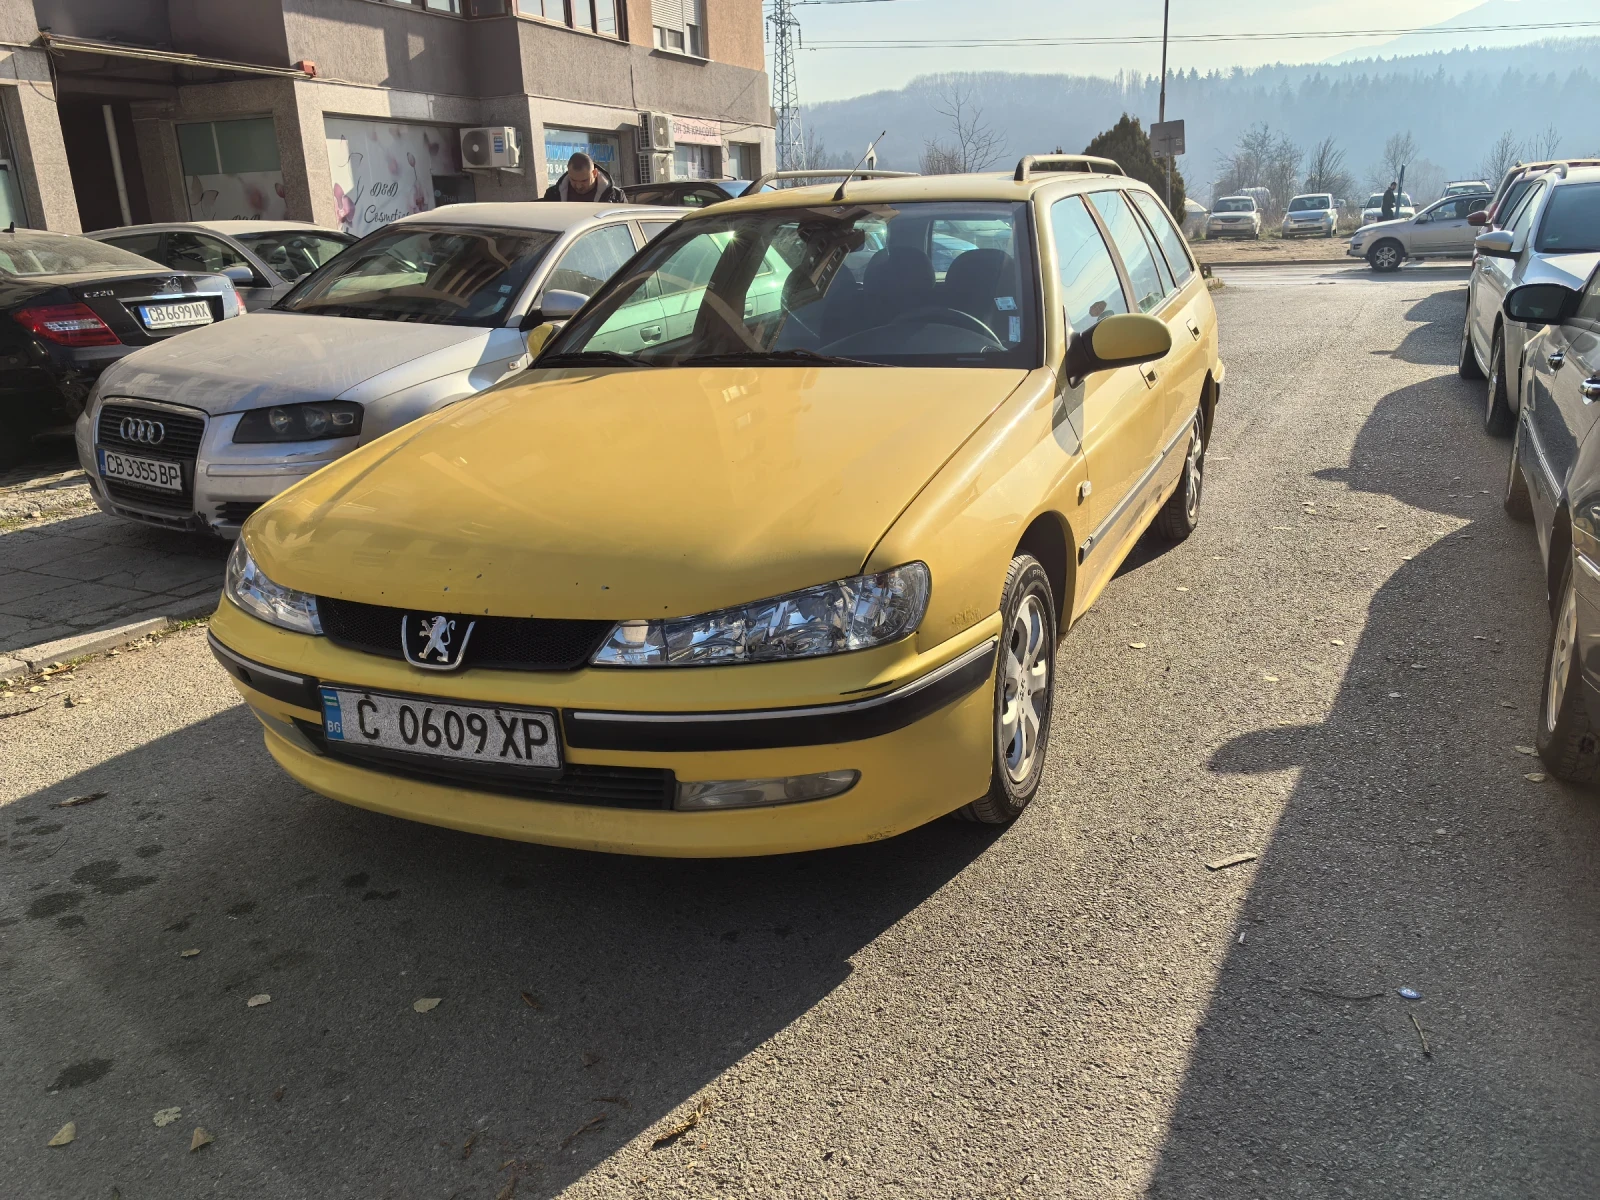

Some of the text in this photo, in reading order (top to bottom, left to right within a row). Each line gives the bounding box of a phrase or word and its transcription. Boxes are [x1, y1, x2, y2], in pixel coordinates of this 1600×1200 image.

[327, 720, 341, 733] BG
[357, 699, 548, 760] C 0609 XP
